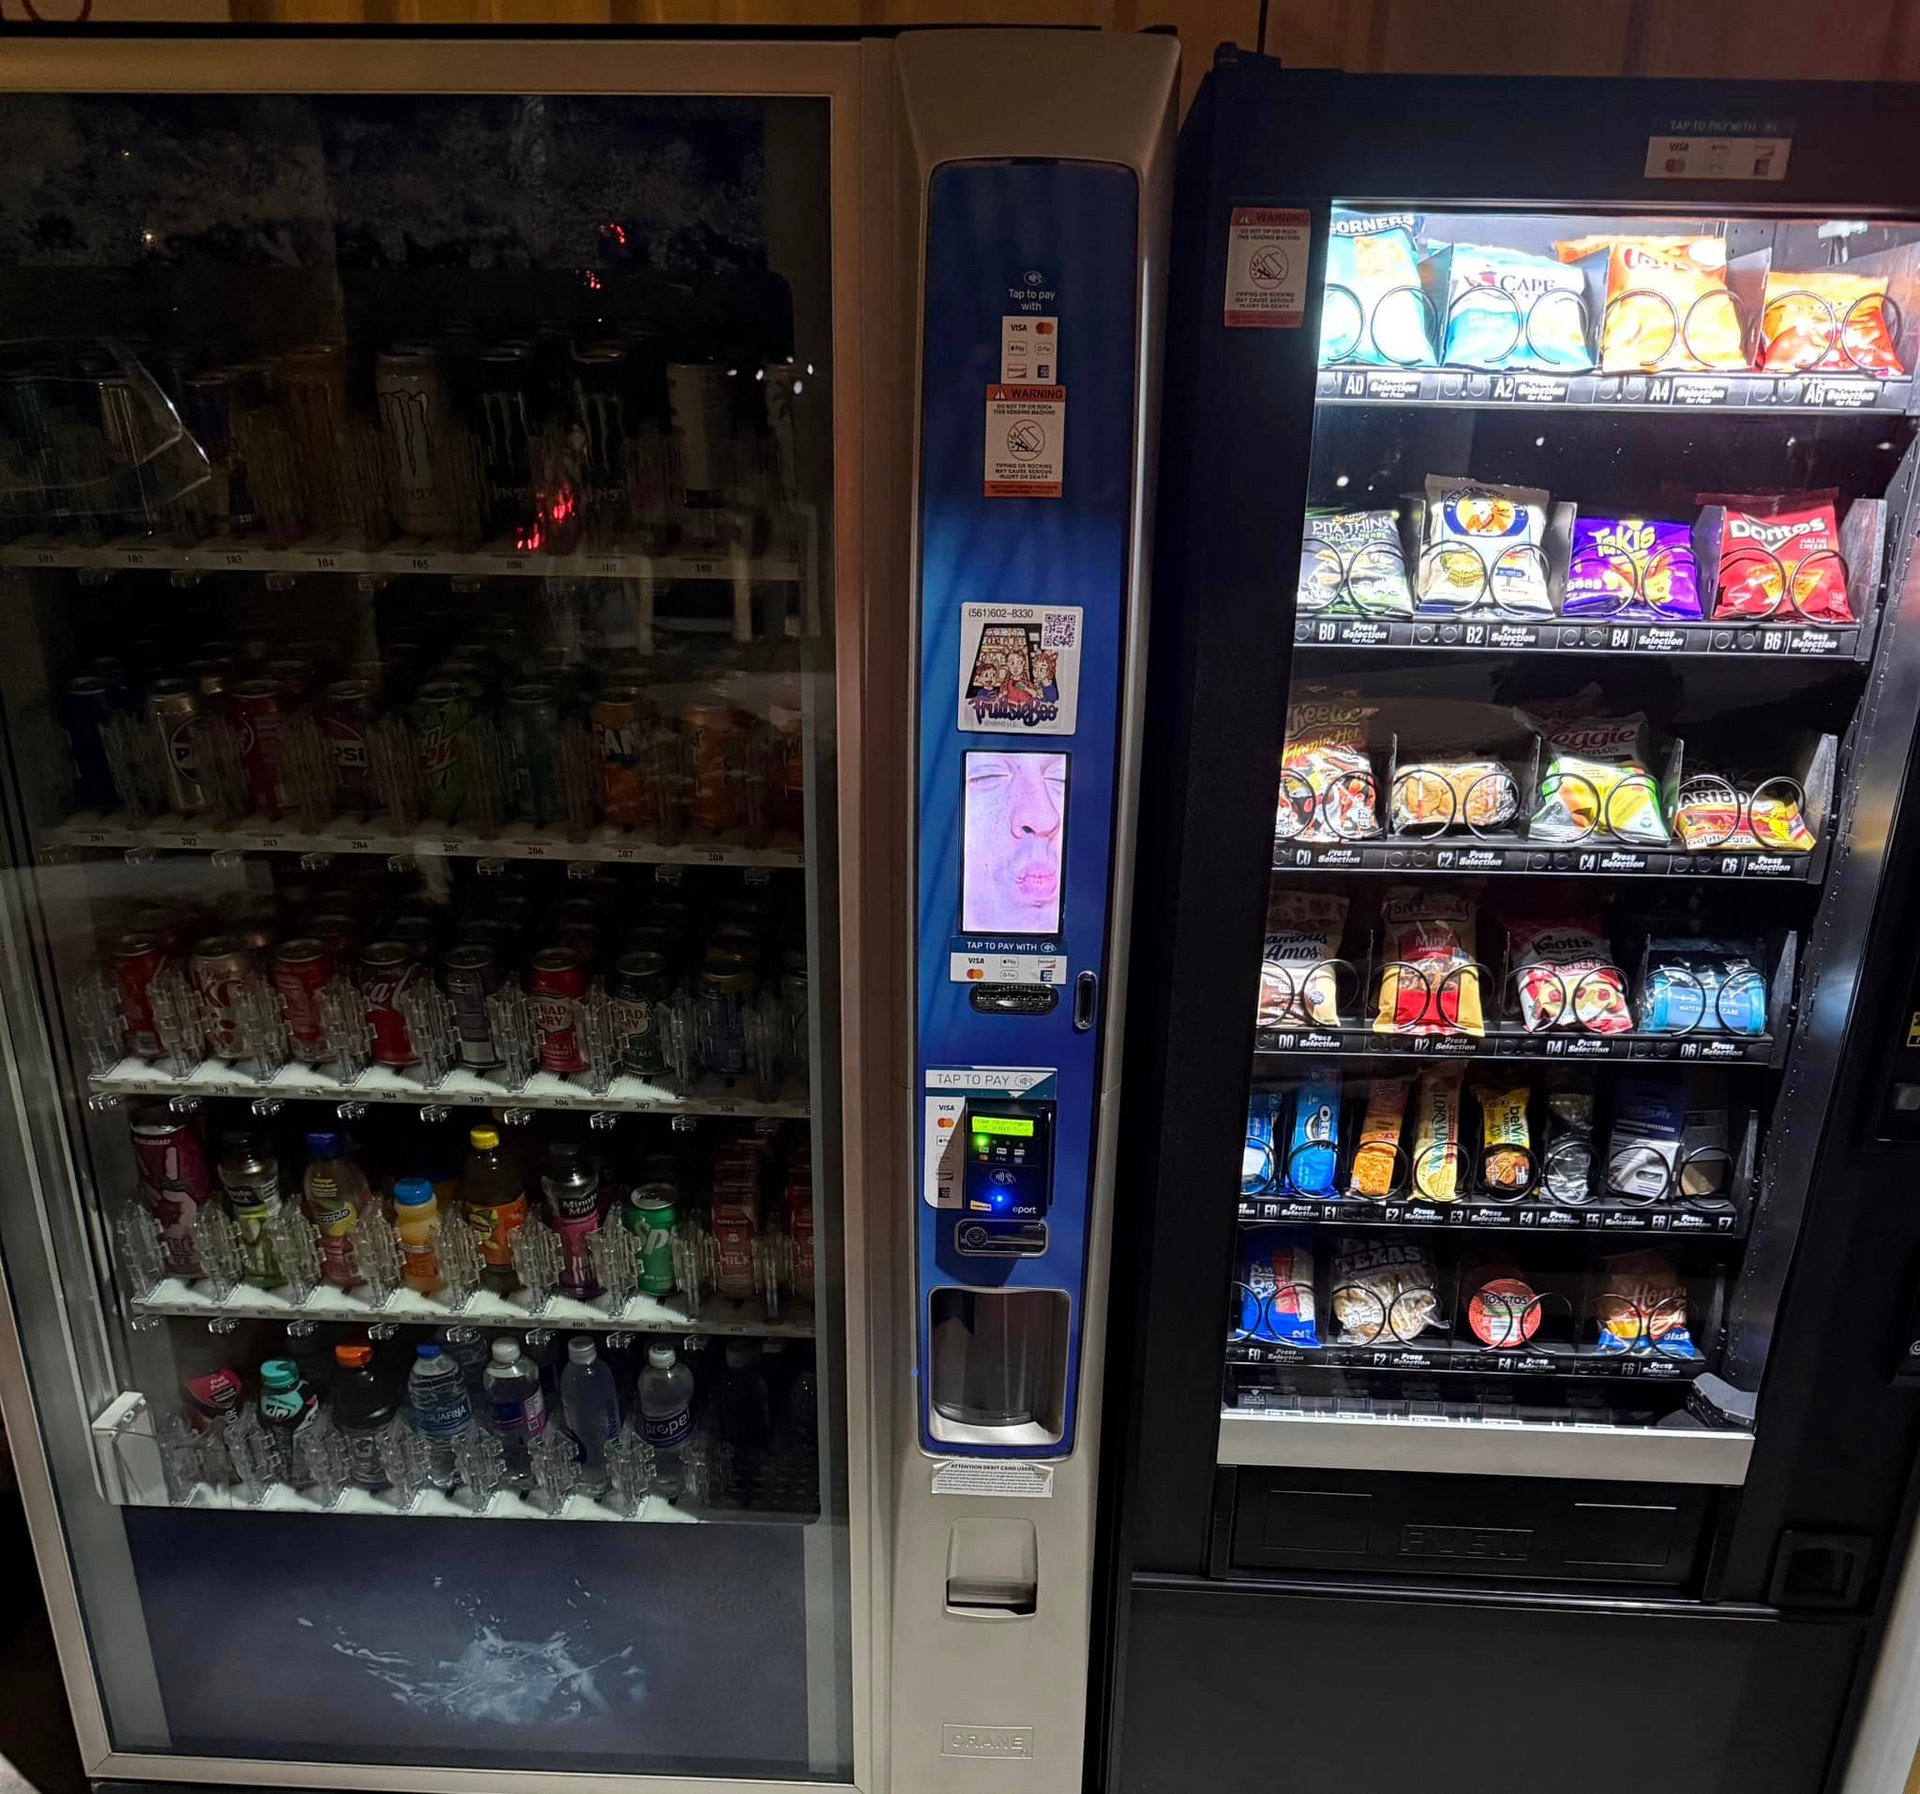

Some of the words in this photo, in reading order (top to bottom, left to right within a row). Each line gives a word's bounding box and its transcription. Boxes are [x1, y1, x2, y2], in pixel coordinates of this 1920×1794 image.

[1670, 120, 1690, 131] TAP
[1693, 120, 1705, 131] TO
[1708, 121, 1727, 132] PAY
[1728, 121, 1756, 132] WITH
[1670, 142, 1689, 151] VISA
[1256, 212, 1306, 222] WARNING
[1500, 275, 1556, 292] CAPE
[1009, 288, 1025, 300] Tap
[1026, 289, 1037, 299] to
[1039, 290, 1056, 301] pay
[1021, 301, 1042, 312] with
[1010, 324, 1028, 332] VISA
[1345, 375, 1364, 395] A0
[1370, 380, 1418, 393] Selection
[1494, 378, 1513, 398] A2
[1518, 383, 1565, 396] Selection
[1011, 388, 1063, 400] WARNING
[1650, 380, 1669, 401] A4
[1804, 383, 1823, 403] A6
[1827, 388, 1874, 401] Selection
[1312, 519, 1344, 535] PITA
[1346, 516, 1391, 533] THINS
[1729, 517, 1826, 541] Doritos
[1588, 525, 1656, 557] Takis
[38, 555, 54, 563] 101
[127, 555, 143, 564] 102
[226, 555, 242, 564] 103
[317, 558, 334, 567] 104
[412, 560, 429, 569] 105
[968, 608, 1034, 619] (561)602-8330
[1352, 622, 1378, 631] Press
[1501, 625, 1528, 635] Press
[1319, 623, 1336, 641] B0
[1342, 629, 1388, 639] Selection
[1466, 626, 1483, 644] B2
[1649, 628, 1675, 638] Press
[1802, 631, 1829, 641] Press
[1491, 633, 1536, 643] Selection
[1612, 628, 1629, 647] B4
[1638, 635, 1683, 646] Selection
[1764, 631, 1781, 649] B6
[1791, 639, 1837, 649] Selection
[1681, 789, 1749, 807] ARIBO
[182, 837, 196, 846] 202
[262, 838, 278, 848] 203
[352, 841, 368, 850] 204
[528, 846, 544, 855] 206
[618, 850, 633, 858] 207
[1327, 849, 1353, 857] Press
[1468, 851, 1494, 859] Press
[708, 853, 724, 862] 208
[1296, 850, 1311, 865] C0
[1317, 855, 1361, 864] Selection
[1437, 851, 1452, 867] C2
[1458, 857, 1503, 867] Selection
[1611, 853, 1637, 862] Press
[1757, 855, 1784, 865] Press
[1579, 855, 1594, 871] C4
[1601, 859, 1646, 869] Selection
[1721, 858, 1737, 874] C6
[1747, 862, 1791, 872] Selection
[1266, 931, 1328, 945] amous
[1414, 935, 1448, 947] Mini
[966, 941, 983, 949] TAP
[985, 942, 996, 950] TO
[997, 942, 1014, 951] PAY
[1016, 943, 1037, 951] WITH
[1531, 935, 1594, 955] Knott's
[1264, 945, 1320, 960] Amos
[1722, 1007, 1740, 1016] CASE
[1278, 1034, 1294, 1048] D0
[1308, 1033, 1332, 1041] Press
[1444, 1036, 1468, 1044] Press
[1299, 1039, 1341, 1048] Selection
[1414, 1038, 1430, 1051] D2
[1435, 1042, 1476, 1051] Selection
[1546, 1040, 1563, 1054] D4
[1577, 1038, 1601, 1048] Press
[1711, 1041, 1736, 1051] Press
[1567, 1045, 1610, 1054] Selection
[1680, 1043, 1696, 1058] D6
[1701, 1048, 1744, 1057] Selection
[937, 1074, 961, 1084] TAP
[964, 1074, 981, 1085] TO
[985, 1075, 1010, 1086] PAY
[133, 1083, 148, 1091] 301
[214, 1086, 229, 1094] 302
[381, 1092, 396, 1100] 304
[469, 1096, 485, 1104] 305
[554, 1099, 570, 1107] 306
[635, 1102, 651, 1110] 307
[1264, 1204, 1277, 1217] E0
[1289, 1204, 1312, 1212] Press
[1324, 1206, 1337, 1219] E1
[1412, 1208, 1436, 1216] Press
[1479, 1209, 1502, 1217] Press
[1281, 1209, 1319, 1218] Selection
[1385, 1208, 1399, 1221] E2
[1404, 1213, 1443, 1222] Selection
[1450, 1210, 1464, 1223] E3
[1470, 1214, 1511, 1223] Selection
[1519, 1212, 1533, 1225] E4
[1549, 1210, 1572, 1219] Press
[1613, 1212, 1637, 1221] Press
[1681, 1214, 1704, 1222] Press
[1540, 1216, 1580, 1225] Selection
[1586, 1213, 1600, 1227] E5
[1604, 1218, 1645, 1227] Selection
[1652, 1215, 1667, 1228] E6
[1672, 1219, 1712, 1229] Selection
[1718, 1217, 1732, 1230] E7
[1335, 1245, 1424, 1273] TEXAS
[1248, 1349, 1260, 1360] F0
[1267, 1353, 1304, 1361] Selection
[1373, 1353, 1387, 1365] F2
[1401, 1352, 1424, 1360] Press
[1393, 1358, 1431, 1366] Selection
[1498, 1357, 1511, 1370] F4
[1517, 1362, 1557, 1371] Selection
[1621, 1362, 1635, 1375] F6
[1642, 1366, 1681, 1375] Selection
[1401, 1529, 1532, 1558] PUSH
[952, 1733, 1024, 1750] CRANE
